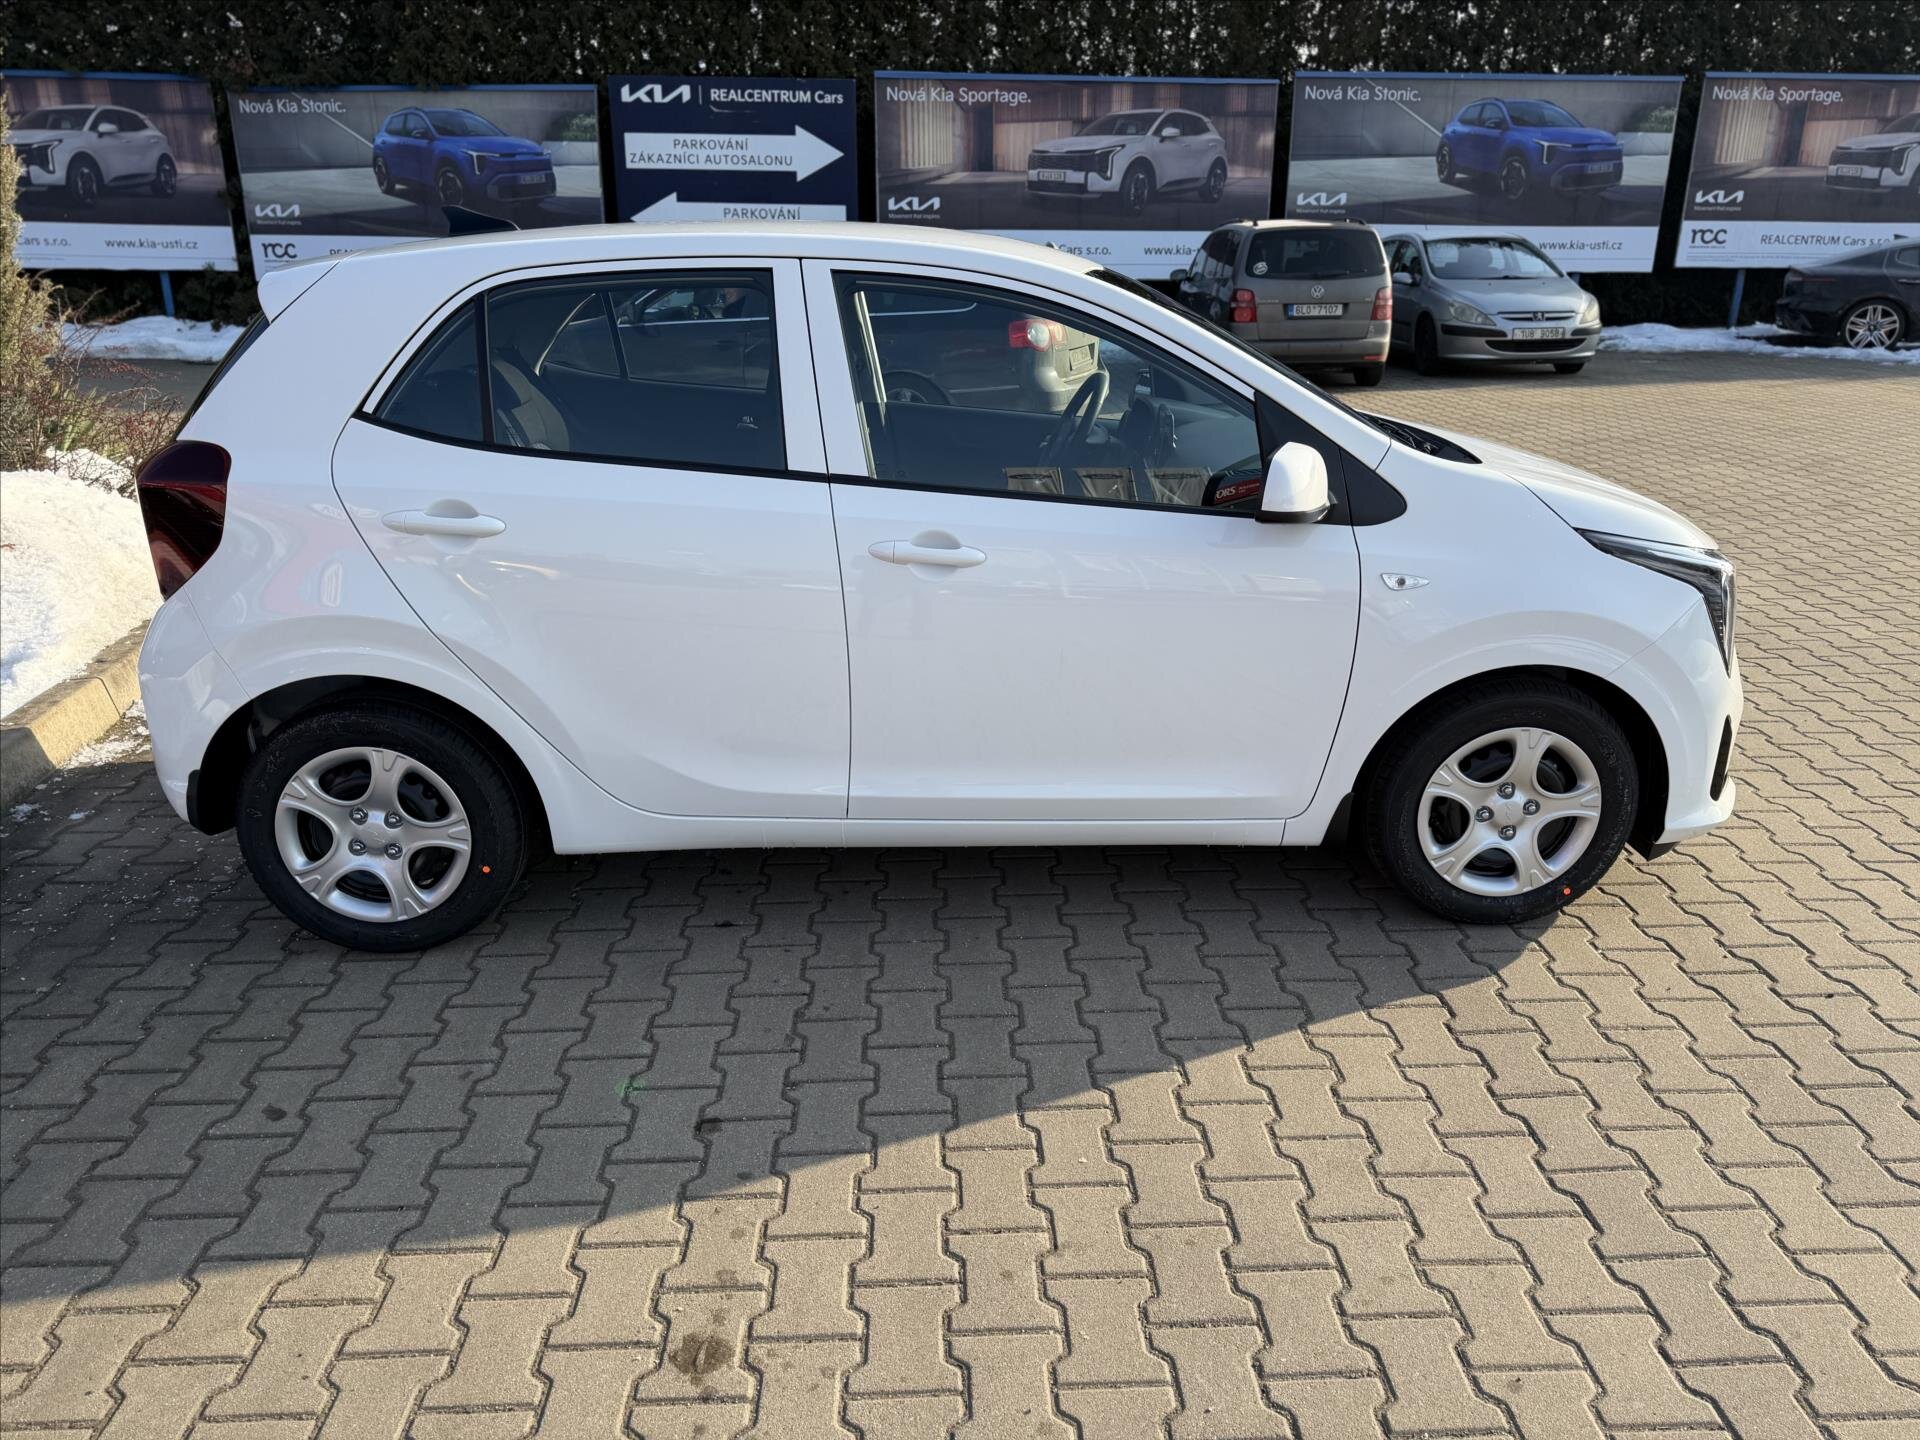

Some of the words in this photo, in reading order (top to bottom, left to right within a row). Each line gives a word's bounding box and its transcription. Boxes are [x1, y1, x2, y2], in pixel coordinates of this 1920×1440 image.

[710, 88, 811, 103] REALCENTRUM
[814, 90, 844, 104] Cars
[886, 86, 926, 101] Nová
[930, 87, 954, 101] Kia
[959, 87, 1031, 106] Sportage.
[1304, 85, 1343, 101] Nová
[1347, 86, 1370, 101] Kia
[1374, 86, 1421, 102] Stonic.
[1712, 85, 1750, 100] Nová
[1751, 86, 1775, 101] Kia
[1778, 86, 1844, 105] Sportage.
[239, 98, 273, 113] Nová
[276, 98, 298, 113] Kia
[301, 98, 346, 113] Stonic.
[673, 138, 749, 151] PARKOVÁNÍ
[630, 151, 700, 165] ZÁKAZNÍCI
[704, 153, 793, 166] AUTOSALONU
[723, 206, 801, 220] PARKOVÁNÍ
[44, 236, 72, 247] s.r.o.
[104, 237, 199, 249] www.kia-usti.cz
[1539, 240, 1623, 250] www.kia-usti.cz
[1760, 234, 1840, 246] REALCENTRUM
[1843, 235, 1866, 247] Cars
[1086, 245, 1112, 256] s.r.o.
